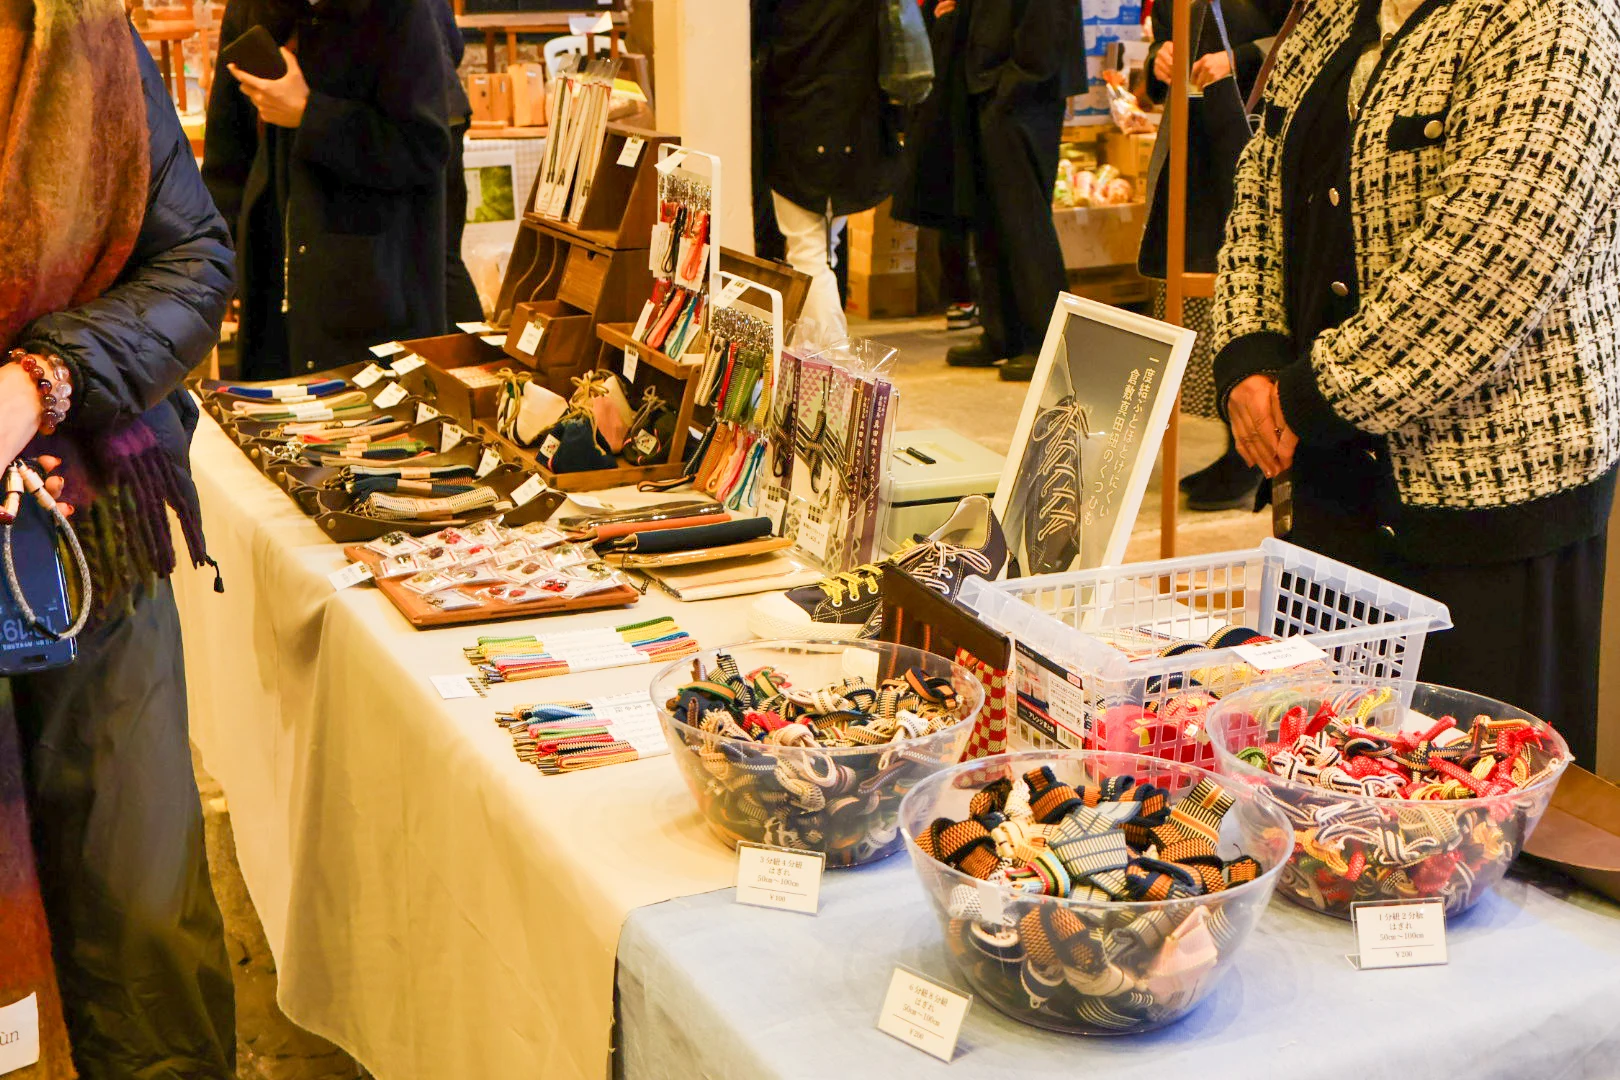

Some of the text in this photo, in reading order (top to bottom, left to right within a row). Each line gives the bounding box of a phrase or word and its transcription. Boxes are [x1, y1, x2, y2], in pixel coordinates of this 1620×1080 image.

[1084, 368, 1141, 526] 倉敷真田紐のくつひも
[768, 866, 791, 877] はぎれ
[1389, 921, 1413, 931] はぎれ
[914, 997, 935, 1013] はぎれ
